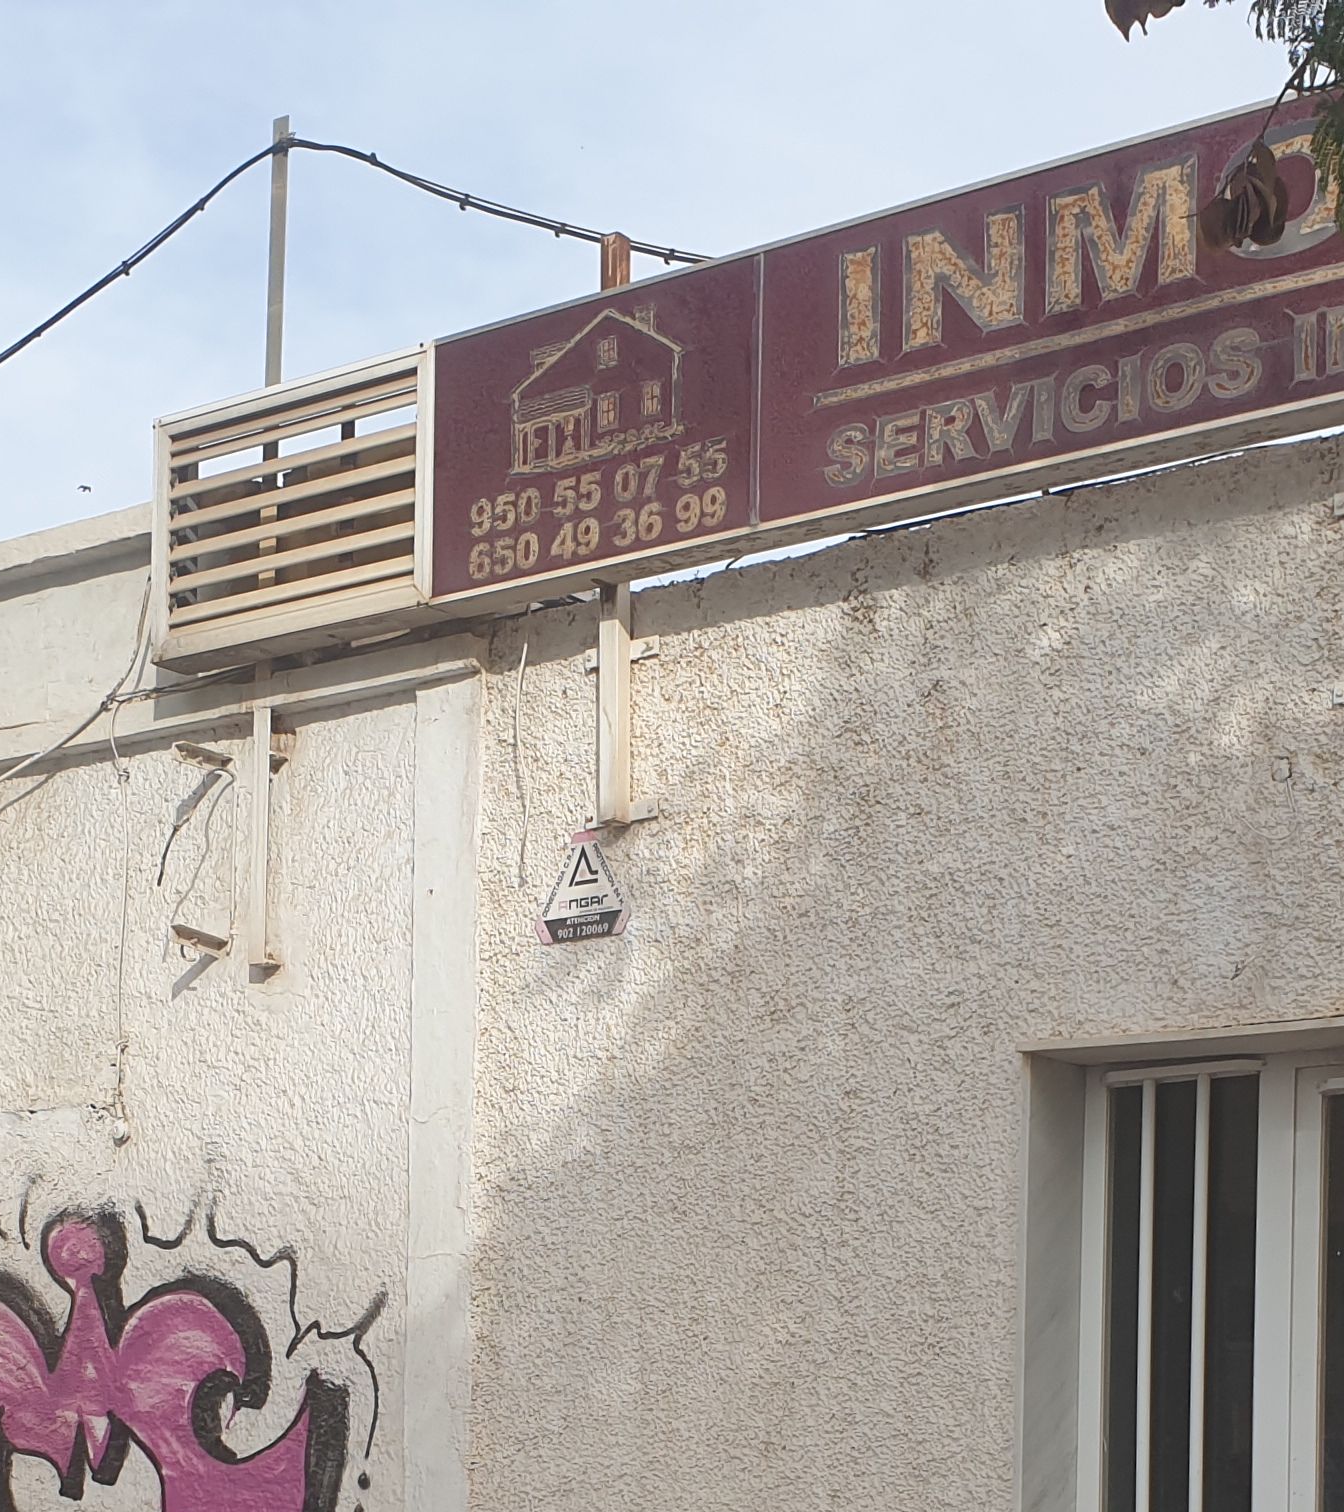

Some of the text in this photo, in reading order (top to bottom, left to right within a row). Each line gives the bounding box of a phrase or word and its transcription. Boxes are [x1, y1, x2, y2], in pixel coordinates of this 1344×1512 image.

[822, 325, 1264, 490] SERVICIOS
[468, 486, 728, 580] 650 49 36 99
[470, 436, 729, 538] 950 55 07 55
[557, 922, 609, 939] 902 120069
